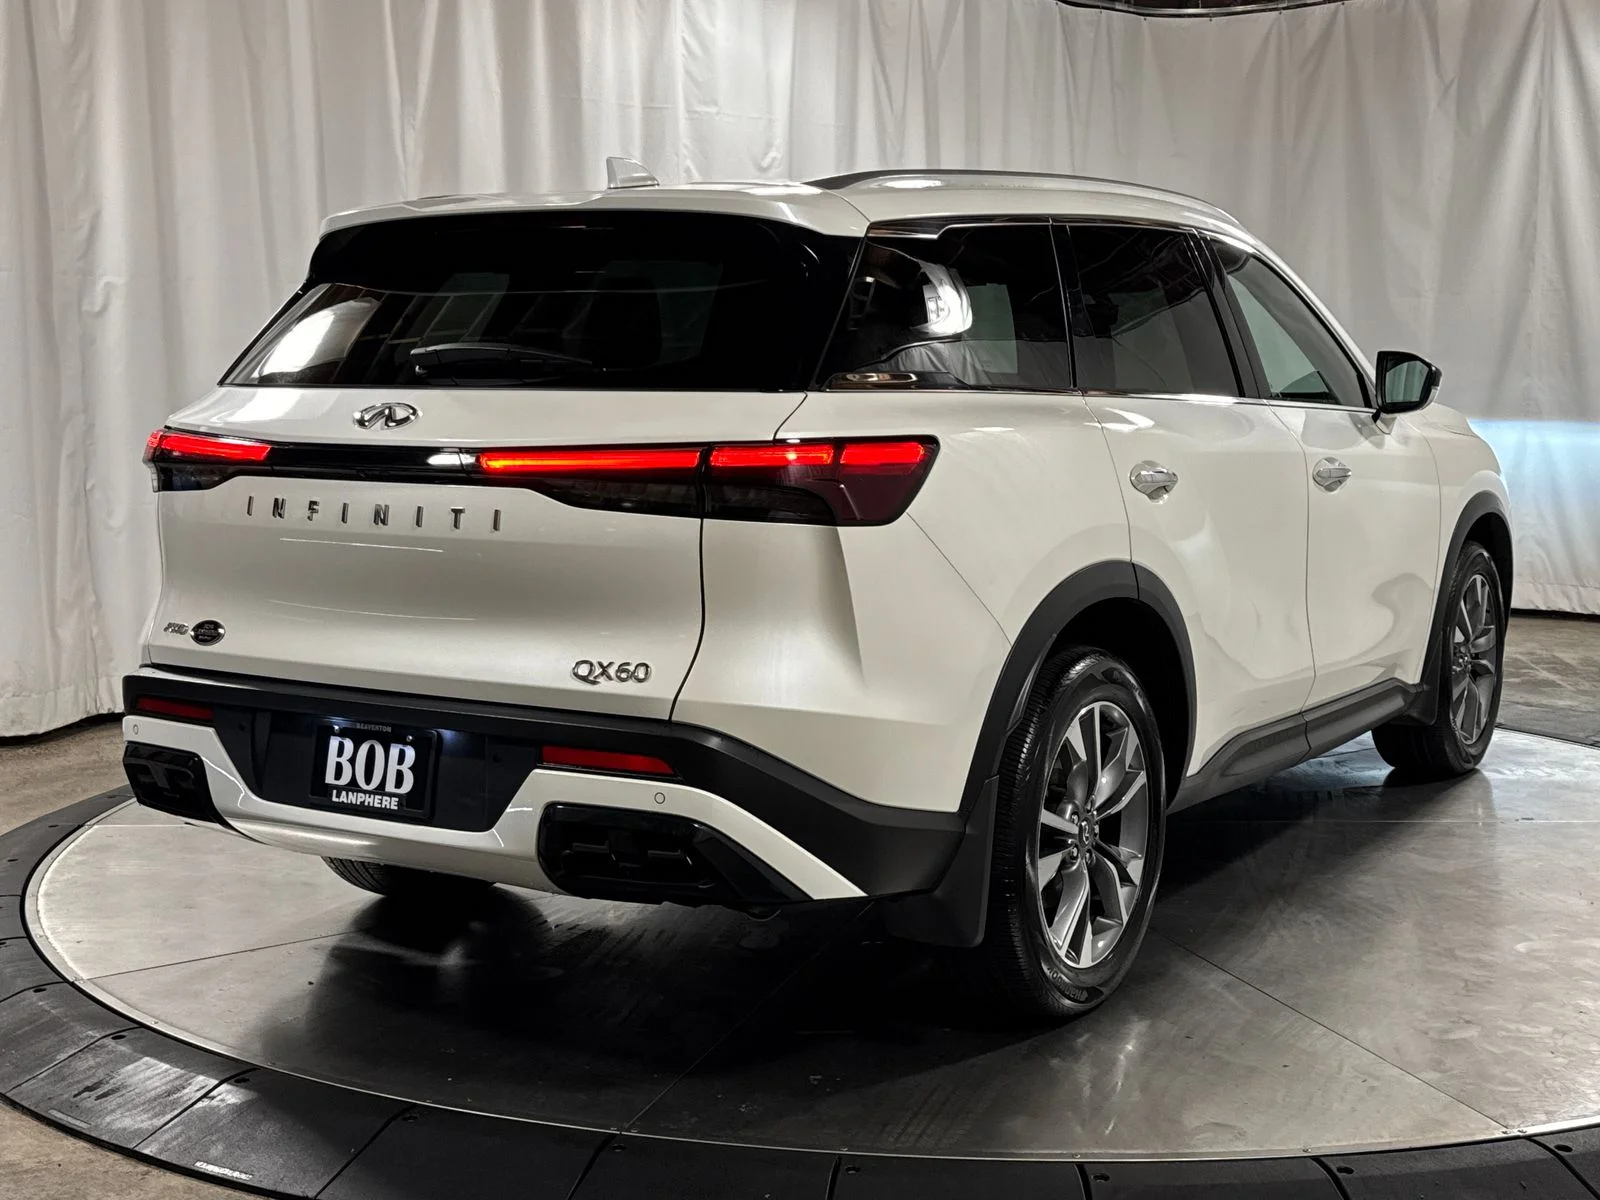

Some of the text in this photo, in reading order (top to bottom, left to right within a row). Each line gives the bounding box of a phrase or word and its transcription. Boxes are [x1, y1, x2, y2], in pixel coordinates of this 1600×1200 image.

[247, 495, 501, 532] INFINITI
[571, 659, 652, 685] QX60
[355, 722, 392, 733] BEAVERTON
[325, 735, 416, 794] BOB
[331, 789, 399, 810] LANPHERE
